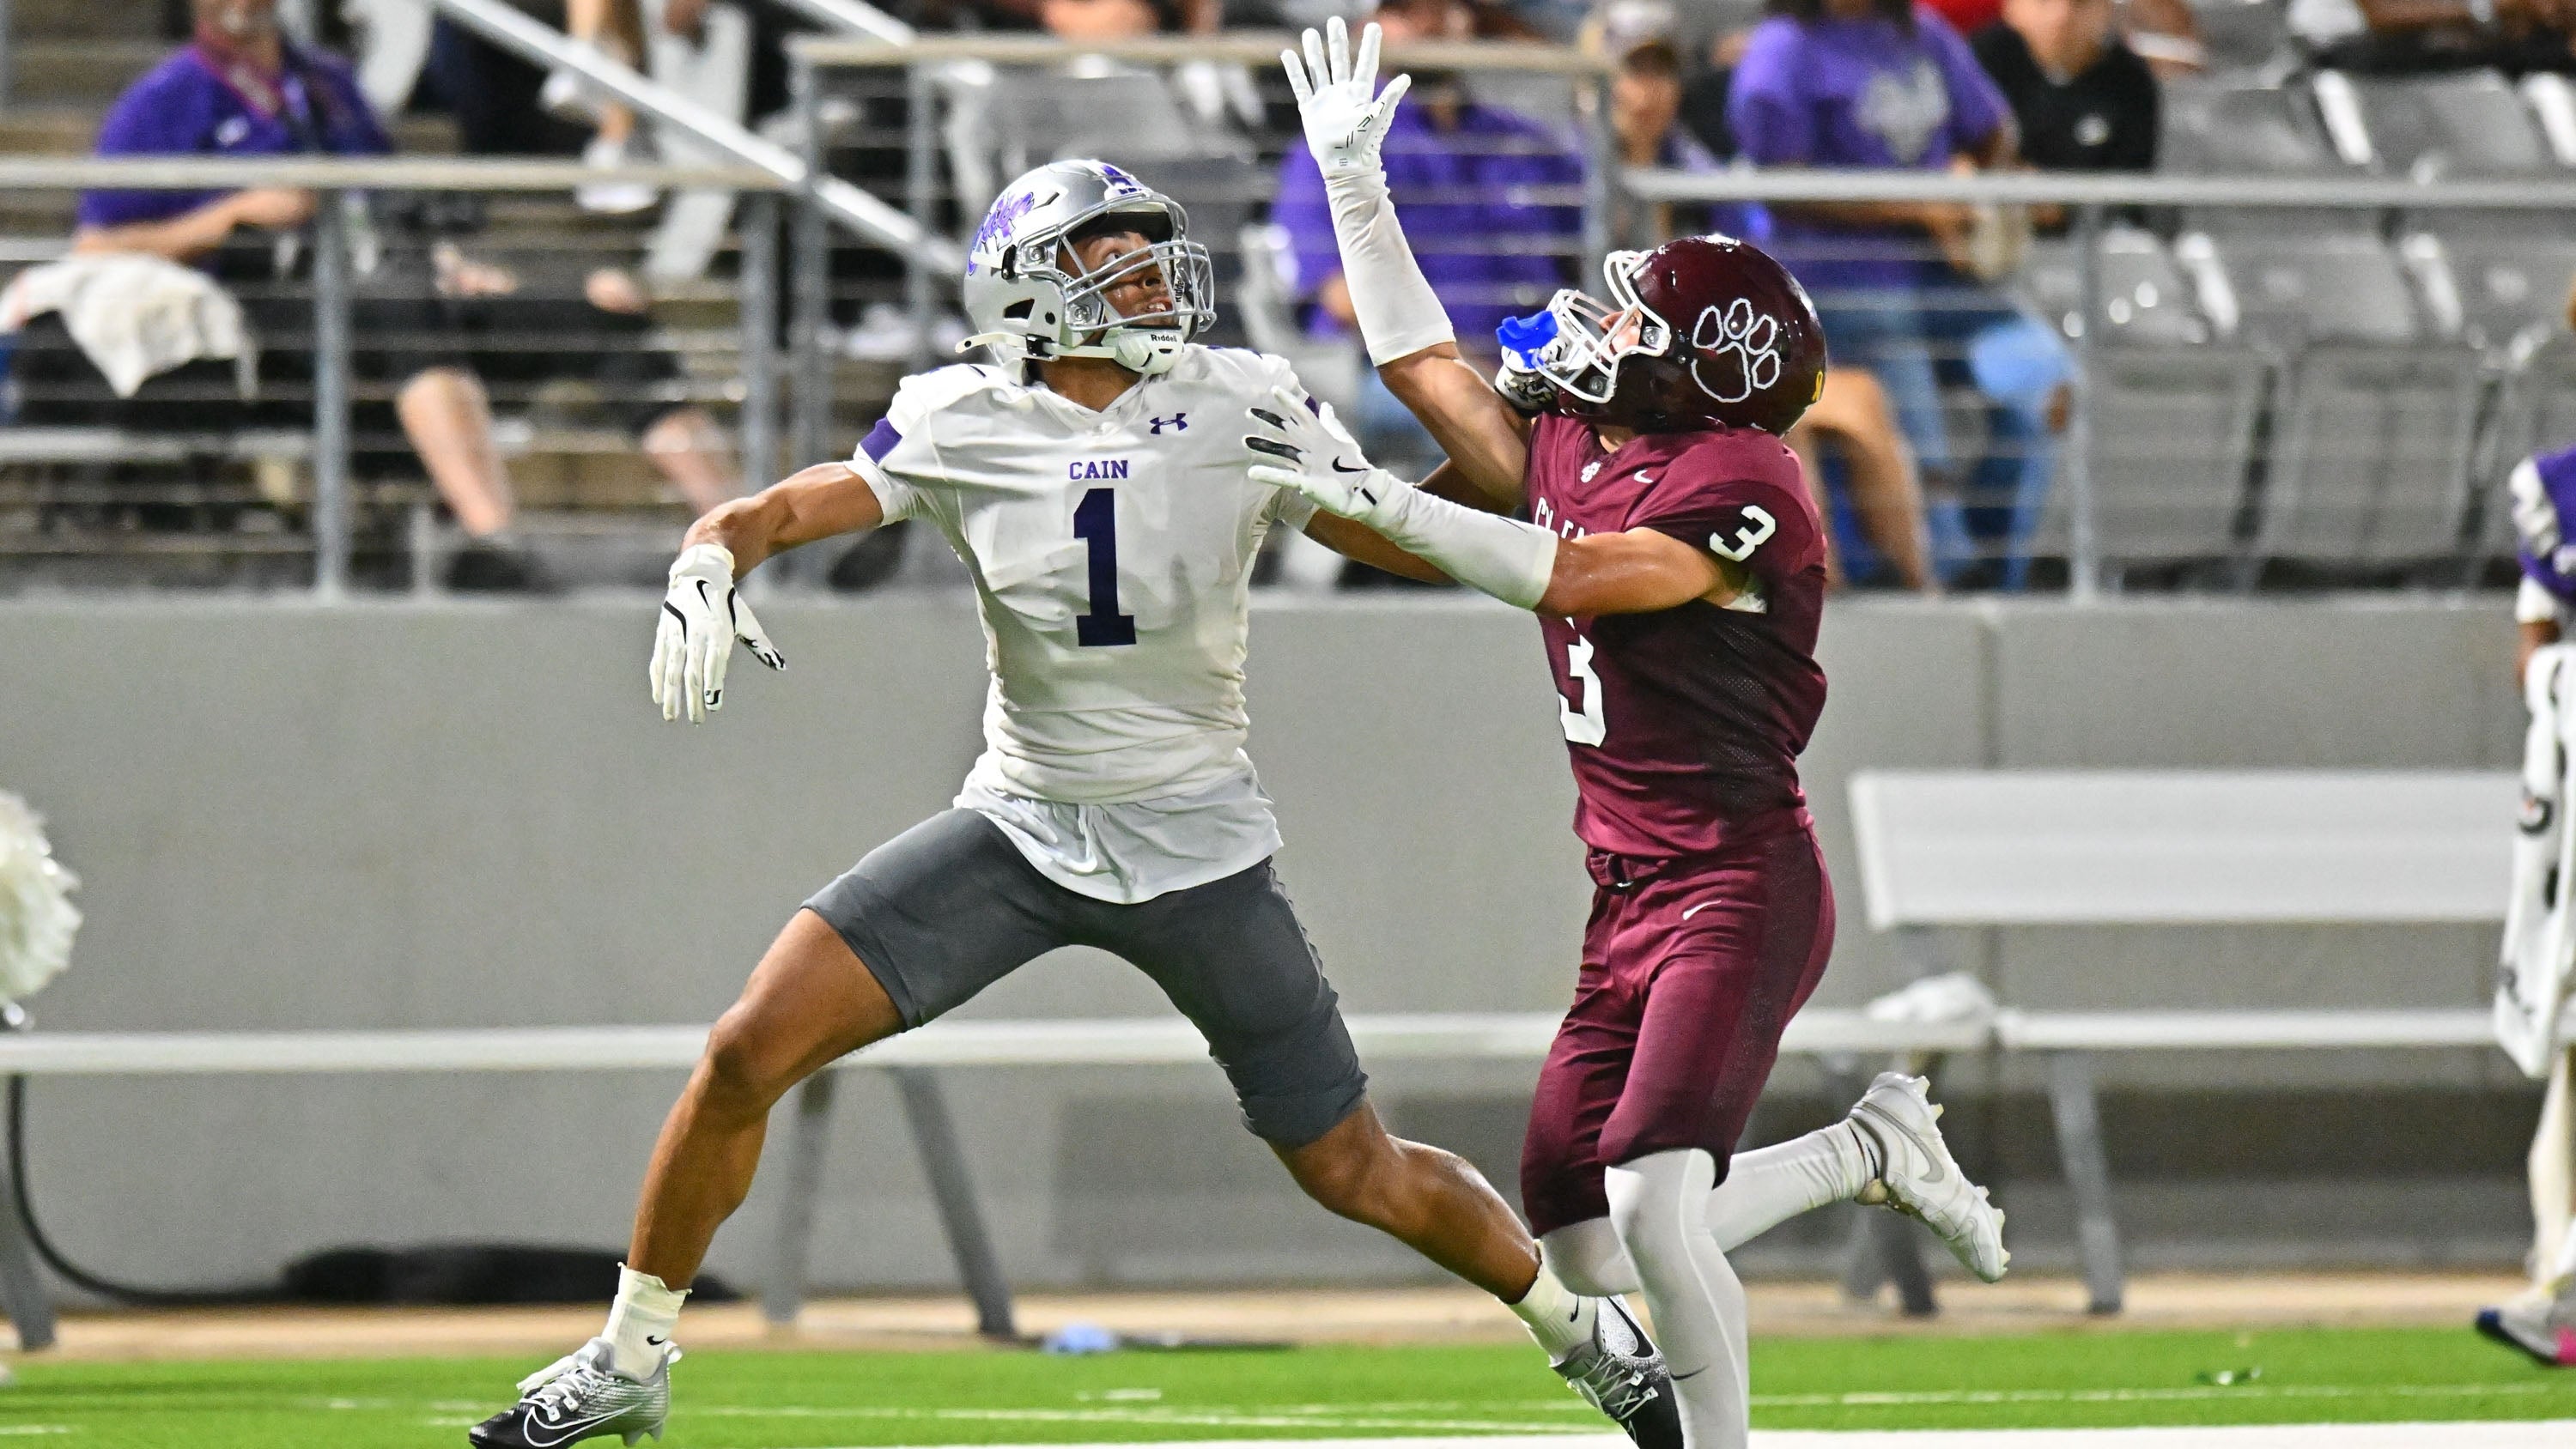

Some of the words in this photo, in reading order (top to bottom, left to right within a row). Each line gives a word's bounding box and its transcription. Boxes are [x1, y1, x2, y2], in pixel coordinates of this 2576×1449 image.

[1069, 459, 1128, 480] CAIN
[1073, 488, 1137, 646] 1
[1709, 505, 1776, 563] 3
[1558, 633, 1607, 748] 3
